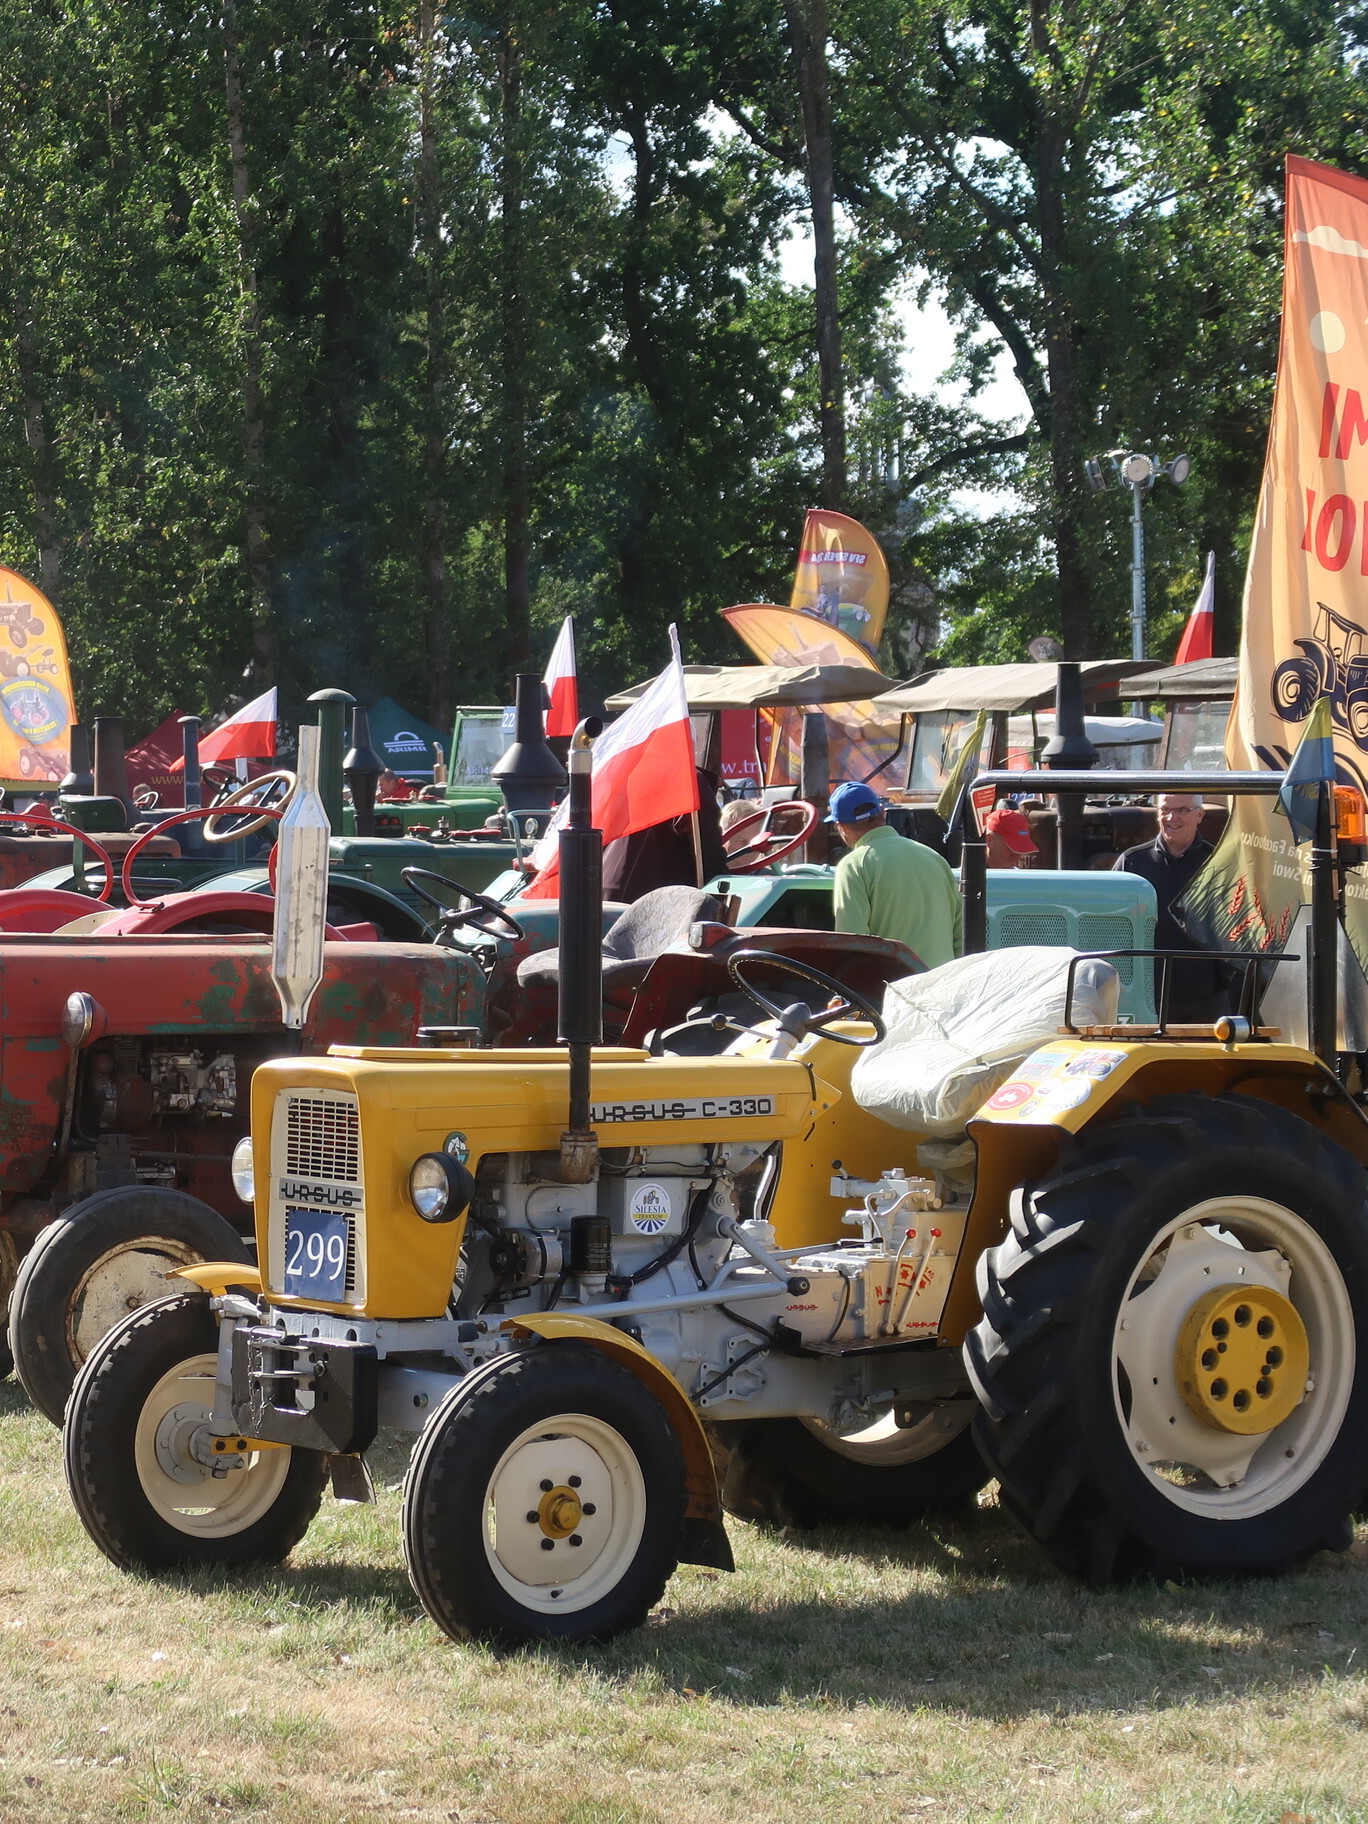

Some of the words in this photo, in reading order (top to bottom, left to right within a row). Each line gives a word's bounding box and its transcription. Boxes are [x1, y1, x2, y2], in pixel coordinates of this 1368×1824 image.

[501, 712, 516, 728] 22
[590, 1103, 696, 1123] URSUS
[702, 1098, 772, 1118] C-330
[281, 1182, 362, 1207] URSUS
[635, 1204, 667, 1214] SILESIA
[286, 1229, 345, 1281] 299
